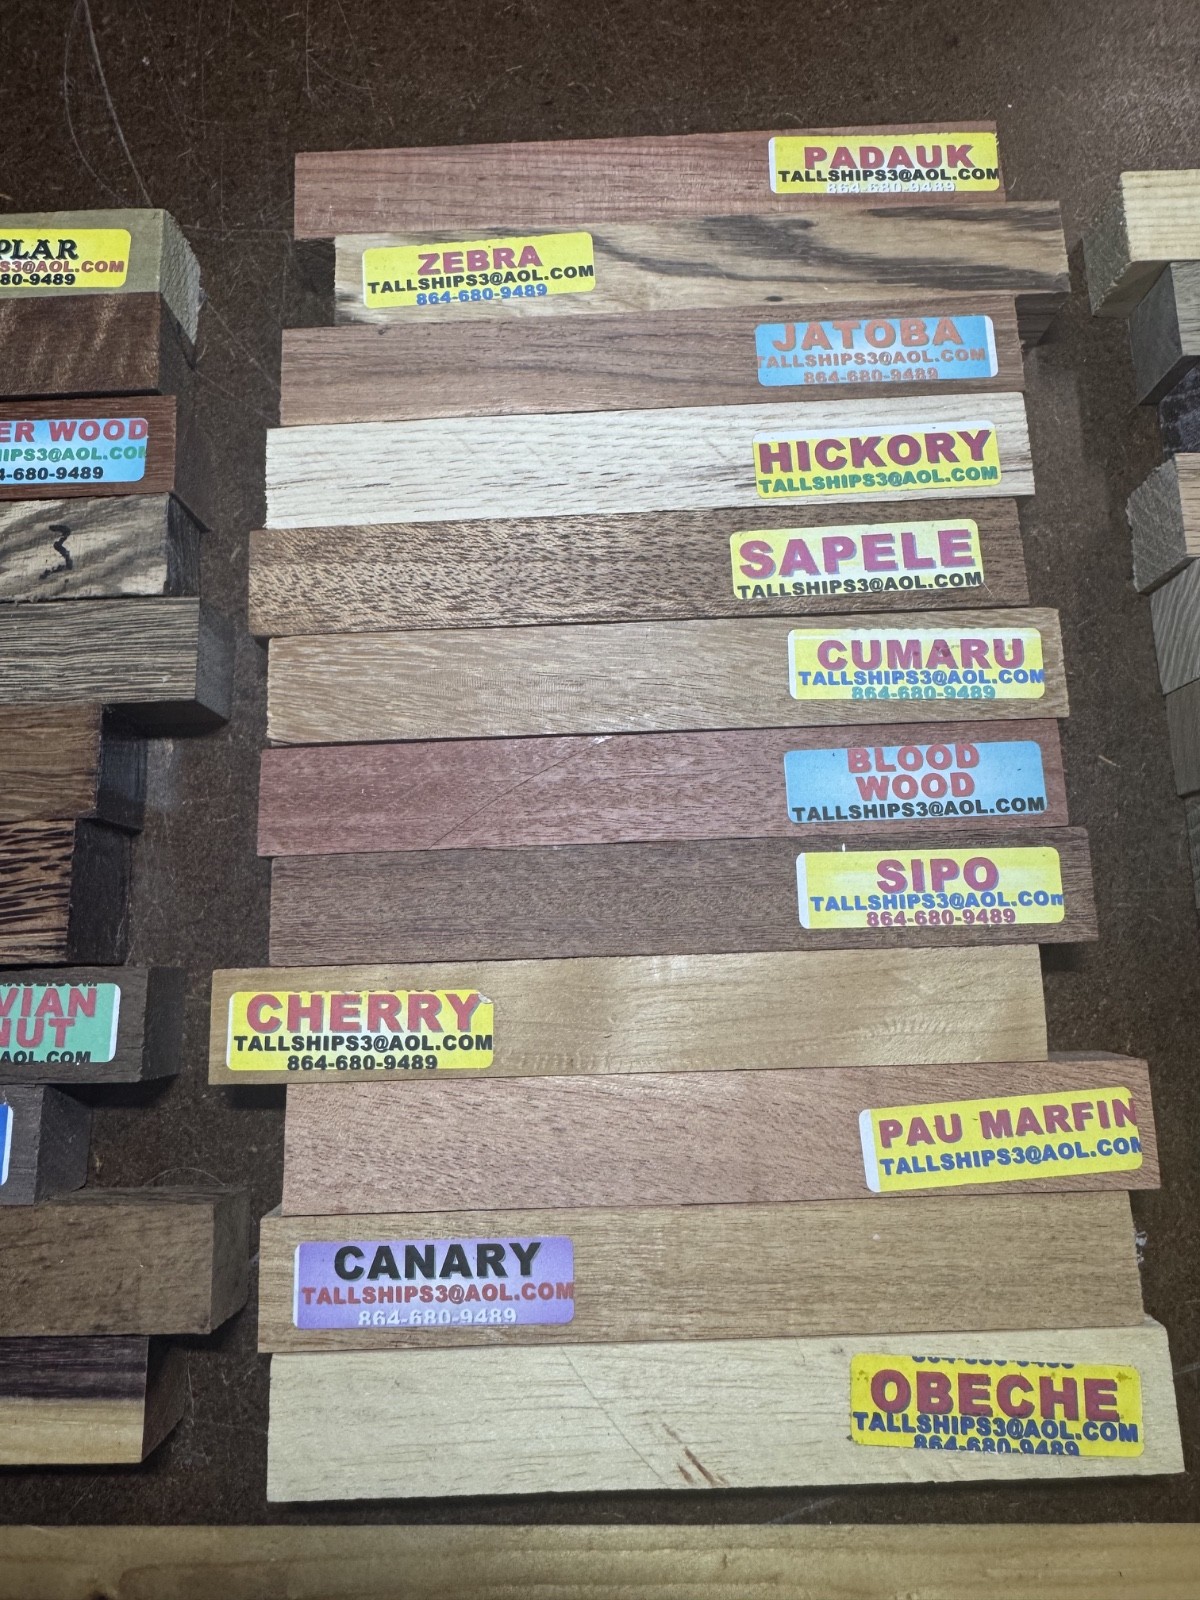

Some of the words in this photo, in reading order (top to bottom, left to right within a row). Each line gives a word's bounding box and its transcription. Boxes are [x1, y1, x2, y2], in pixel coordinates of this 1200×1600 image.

[804, 144, 976, 170] PADAUK
[778, 168, 999, 182] TALLSHIPS3@AOL.COM
[0, 238, 79, 260] PLAR
[417, 245, 544, 276] ZEBRA
[0, 273, 76, 285] 80-9489
[367, 265, 594, 294] TALLSHIPS3@AOL.COM
[416, 283, 548, 305] 864-680-9489
[772, 318, 963, 351] JATOBA
[803, 368, 939, 384] 864-680-9489
[49, 419, 148, 442] WOOD
[758, 429, 993, 474] HICKORY
[758, 465, 998, 494] TALLSHIPS3@AOL.COM
[739, 529, 975, 579] SAPELE
[737, 571, 982, 598] TALLSHIPS3@AOL.COM
[817, 638, 1026, 671] CUMARU
[798, 668, 1045, 686] TALLSHIPS3@AOL.COM
[851, 684, 996, 700] 864-680-9489
[847, 743, 980, 773] BLOOD
[855, 771, 976, 801] WOOD
[792, 796, 1045, 822] TALLSHIPS3@AOL.COM
[876, 856, 1000, 894] SIPO
[866, 908, 1016, 927] 864-680-9489
[0, 987, 97, 1018] VIAN
[246, 993, 482, 1033] CHERRY
[234, 1034, 493, 1052] TALLSHIPS3@AOL.COM
[287, 1054, 438, 1070] 864-680-9489
[878, 1113, 963, 1149] PAU
[978, 1097, 1137, 1140] MARFIN
[333, 1242, 542, 1281] CANARY
[302, 1281, 575, 1305] TALLSHIPS3@AOL.COM
[358, 1307, 517, 1326] 864-680-9489
[870, 1369, 1120, 1422] OBECHE
[853, 1411, 1139, 1443] TALLSHIPS3@AOL.COM
